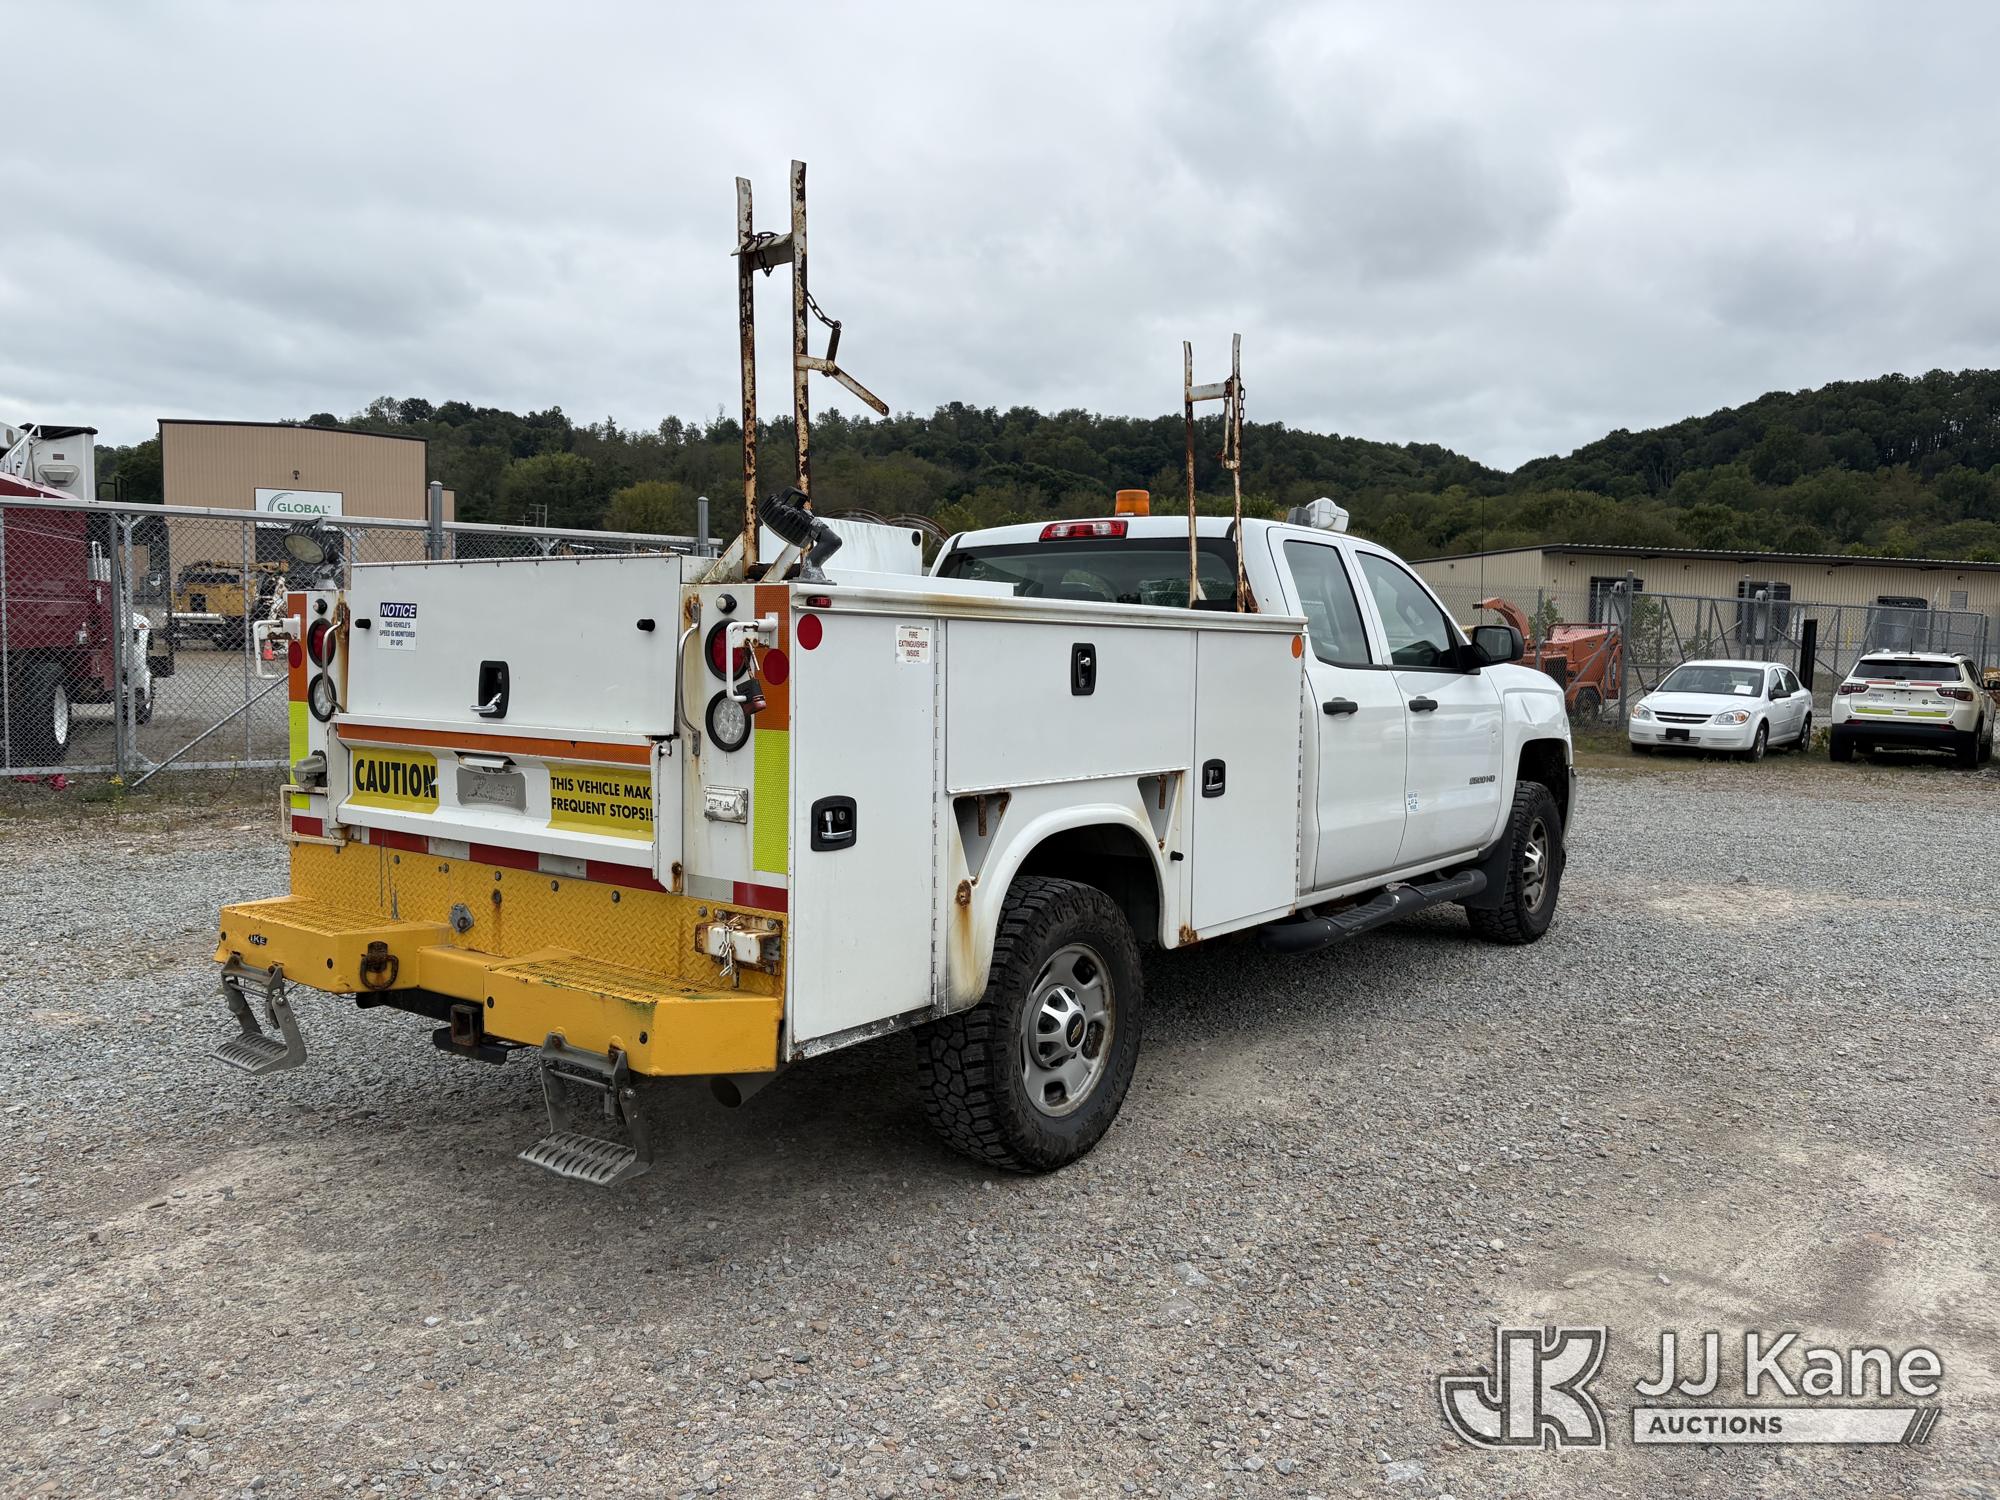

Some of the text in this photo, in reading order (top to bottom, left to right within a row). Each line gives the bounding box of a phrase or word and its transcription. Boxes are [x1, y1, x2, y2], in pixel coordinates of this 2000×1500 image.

[277, 502, 328, 514] GLOBAL
[381, 604, 416, 617] NOTICE
[379, 629, 390, 637] SPEED
[395, 630, 415, 638] MONITORED
[909, 631, 918, 639] FIRE
[899, 640, 928, 648] EXTINGUISHER
[355, 759, 437, 798] CAUTION
[551, 776, 574, 791] THIS
[576, 779, 620, 796] VEHICLE
[551, 797, 654, 822] FREQUENT STOPS!!
